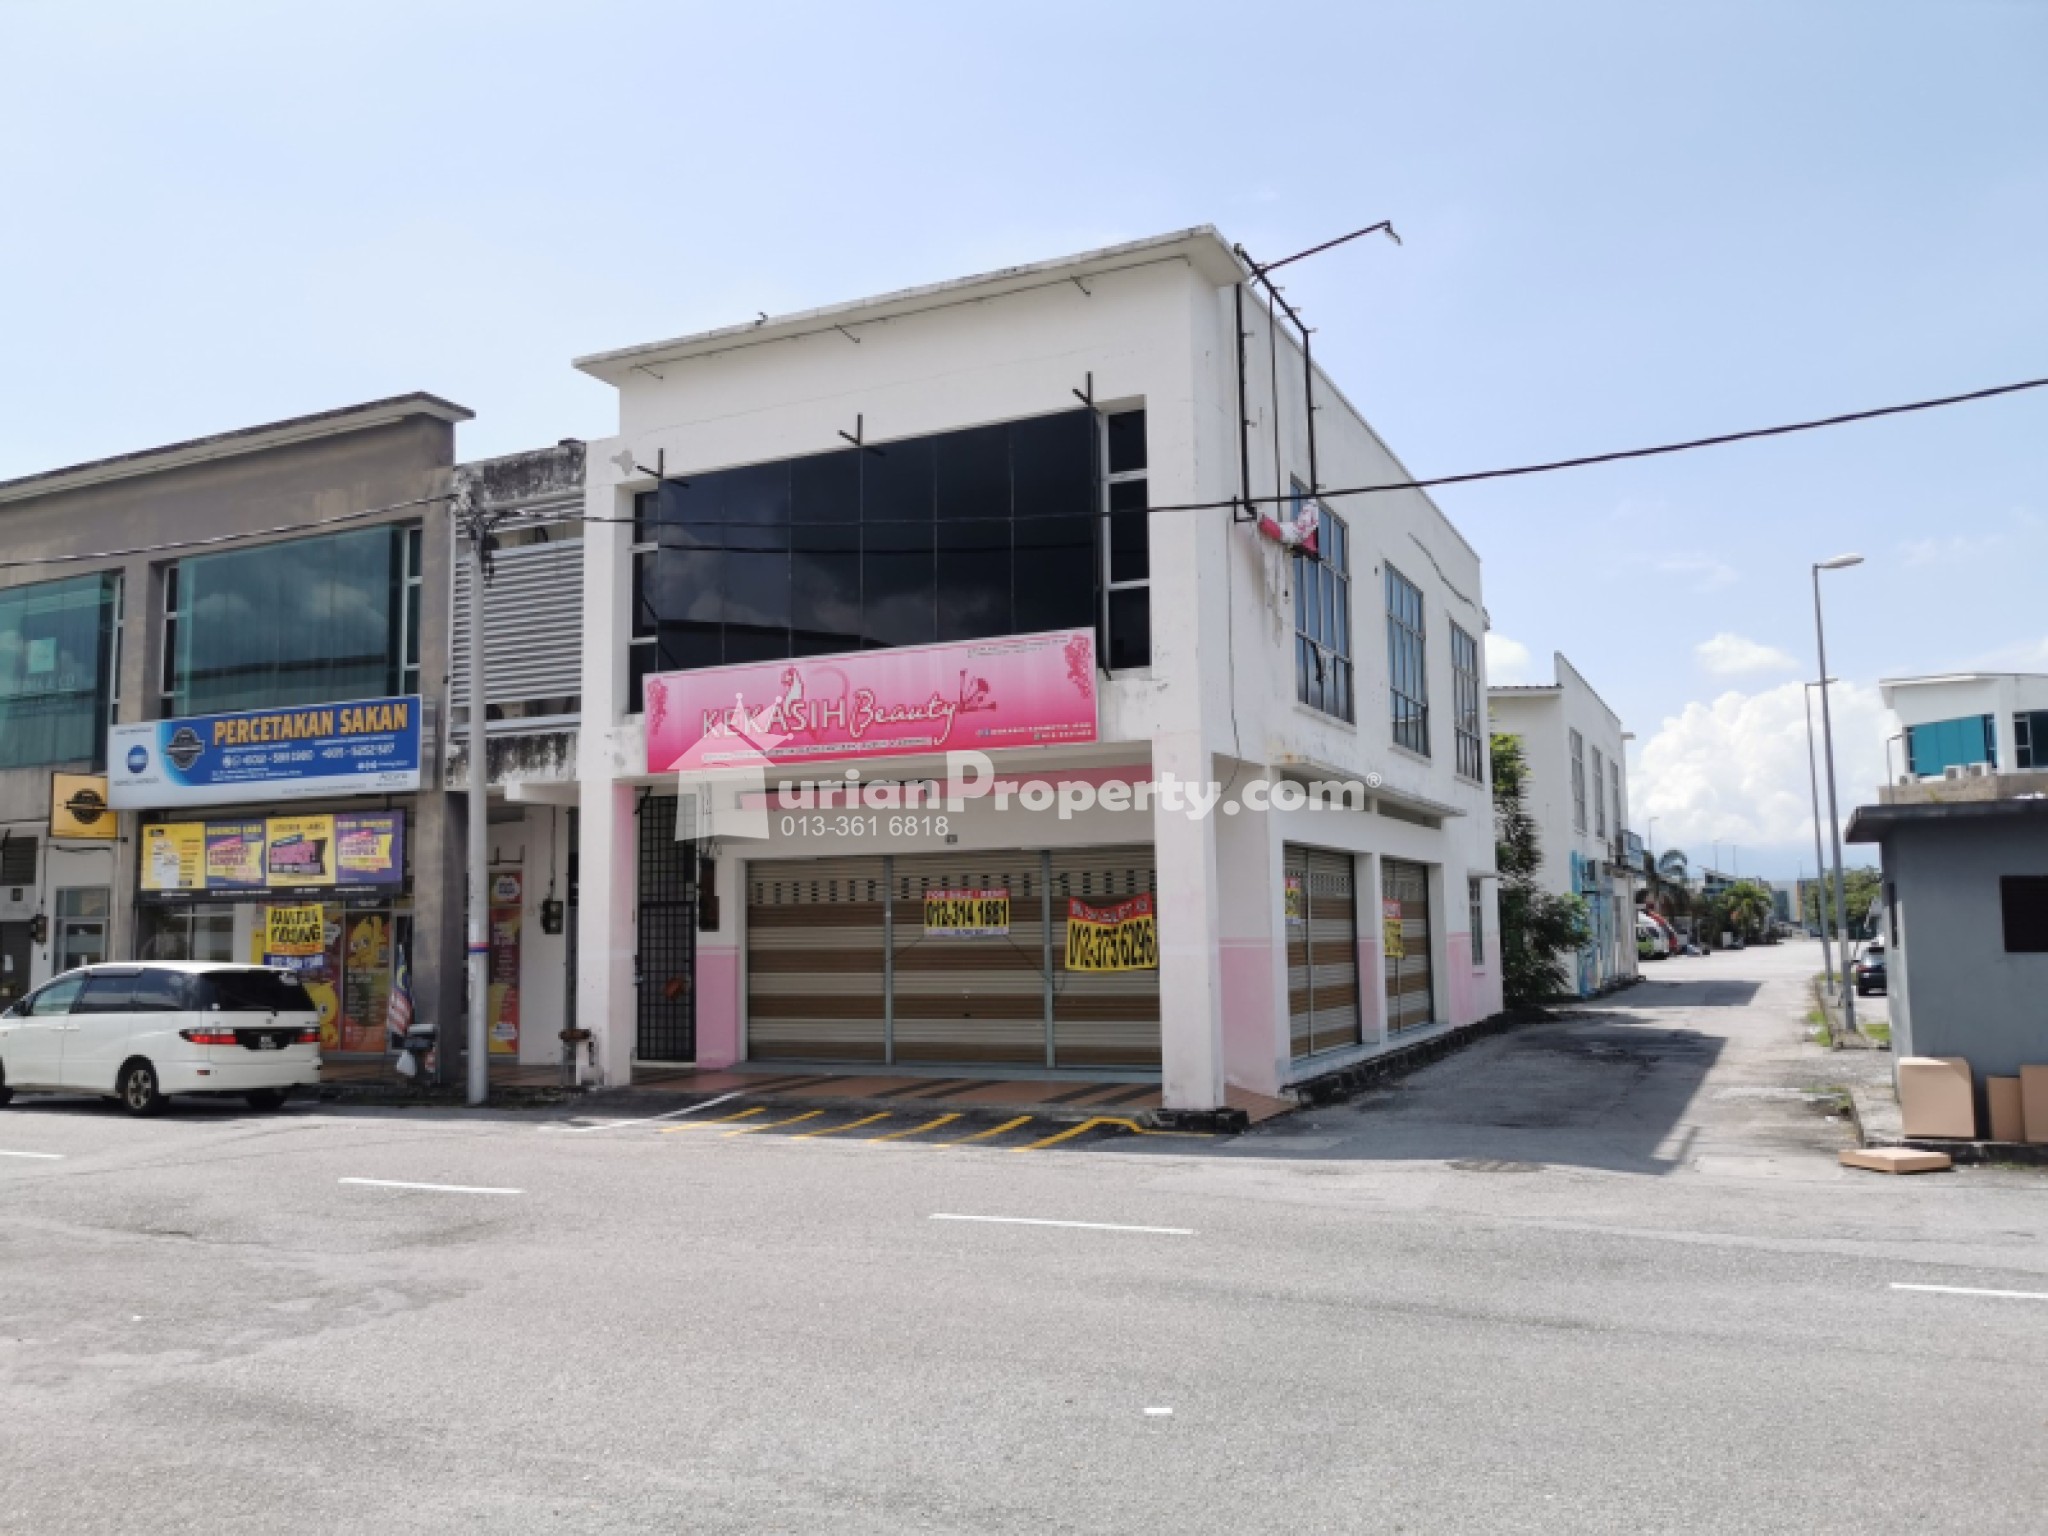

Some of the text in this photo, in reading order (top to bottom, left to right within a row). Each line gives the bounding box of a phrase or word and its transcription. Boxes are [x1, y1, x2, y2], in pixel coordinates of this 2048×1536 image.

[213, 703, 408, 746] PERCETAKAN SAKAN
[703, 688, 956, 745] KEKASIH Beauty
